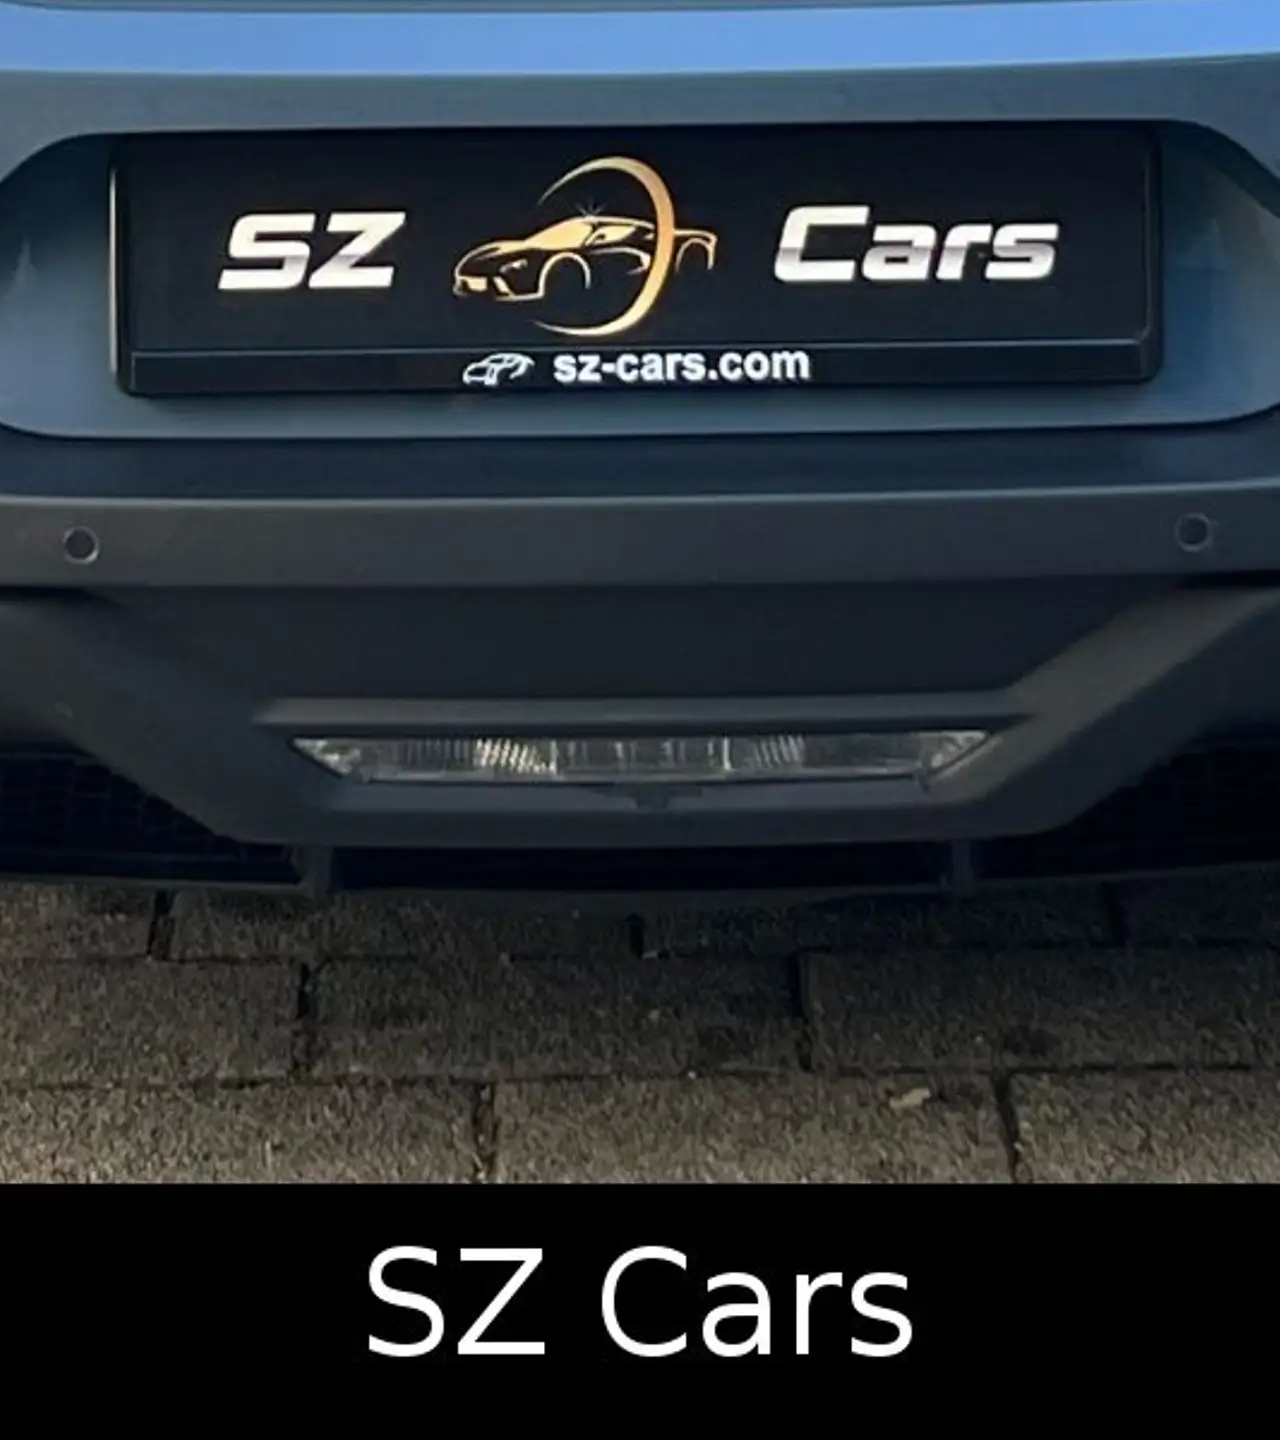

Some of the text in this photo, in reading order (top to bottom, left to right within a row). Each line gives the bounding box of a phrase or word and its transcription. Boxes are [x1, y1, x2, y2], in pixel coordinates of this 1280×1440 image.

[218, 205, 1060, 290] SZ Cars
[552, 346, 811, 384] sz-cars.com
